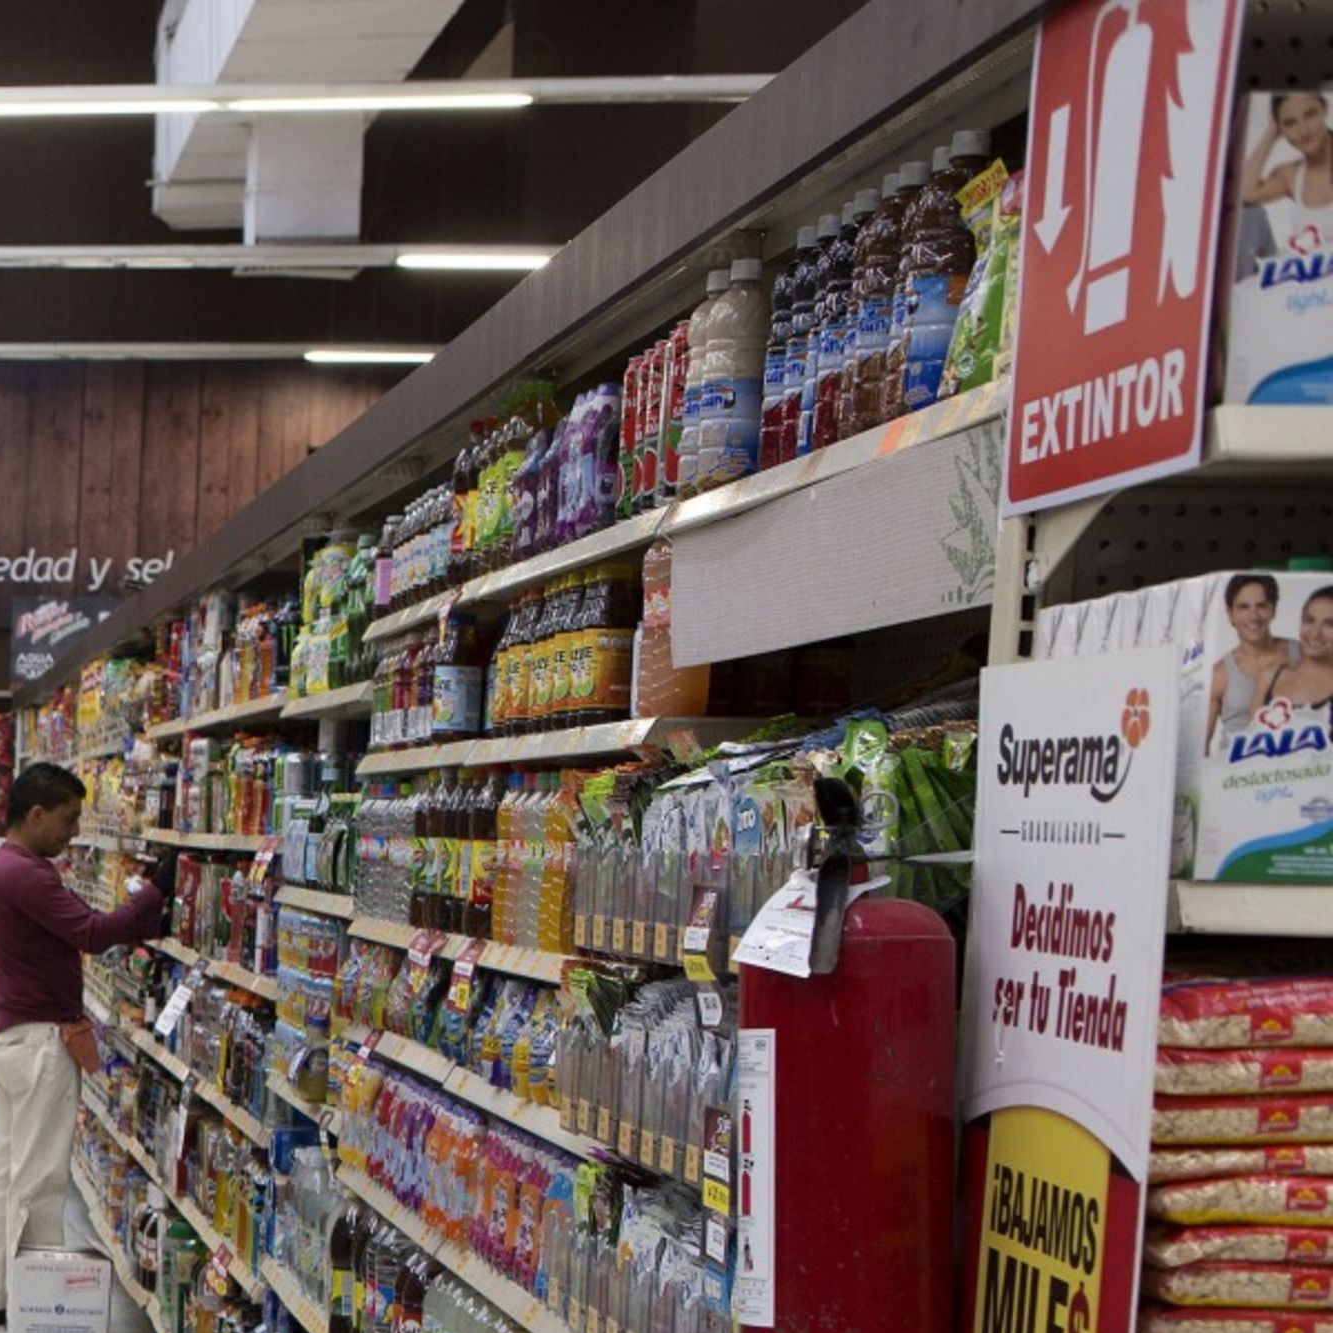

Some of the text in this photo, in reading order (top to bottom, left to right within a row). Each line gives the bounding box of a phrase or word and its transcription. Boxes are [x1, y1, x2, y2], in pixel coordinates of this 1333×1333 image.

[1020, 348, 1185, 465] EXTINTOR
[88, 556, 113, 592] y
[997, 723, 1123, 801] Superama
[1010, 881, 1116, 964] Decidimos
[991, 966, 1128, 1052] ser tu Tienda
[990, 1163, 1100, 1277] ¡BAJAMOS
